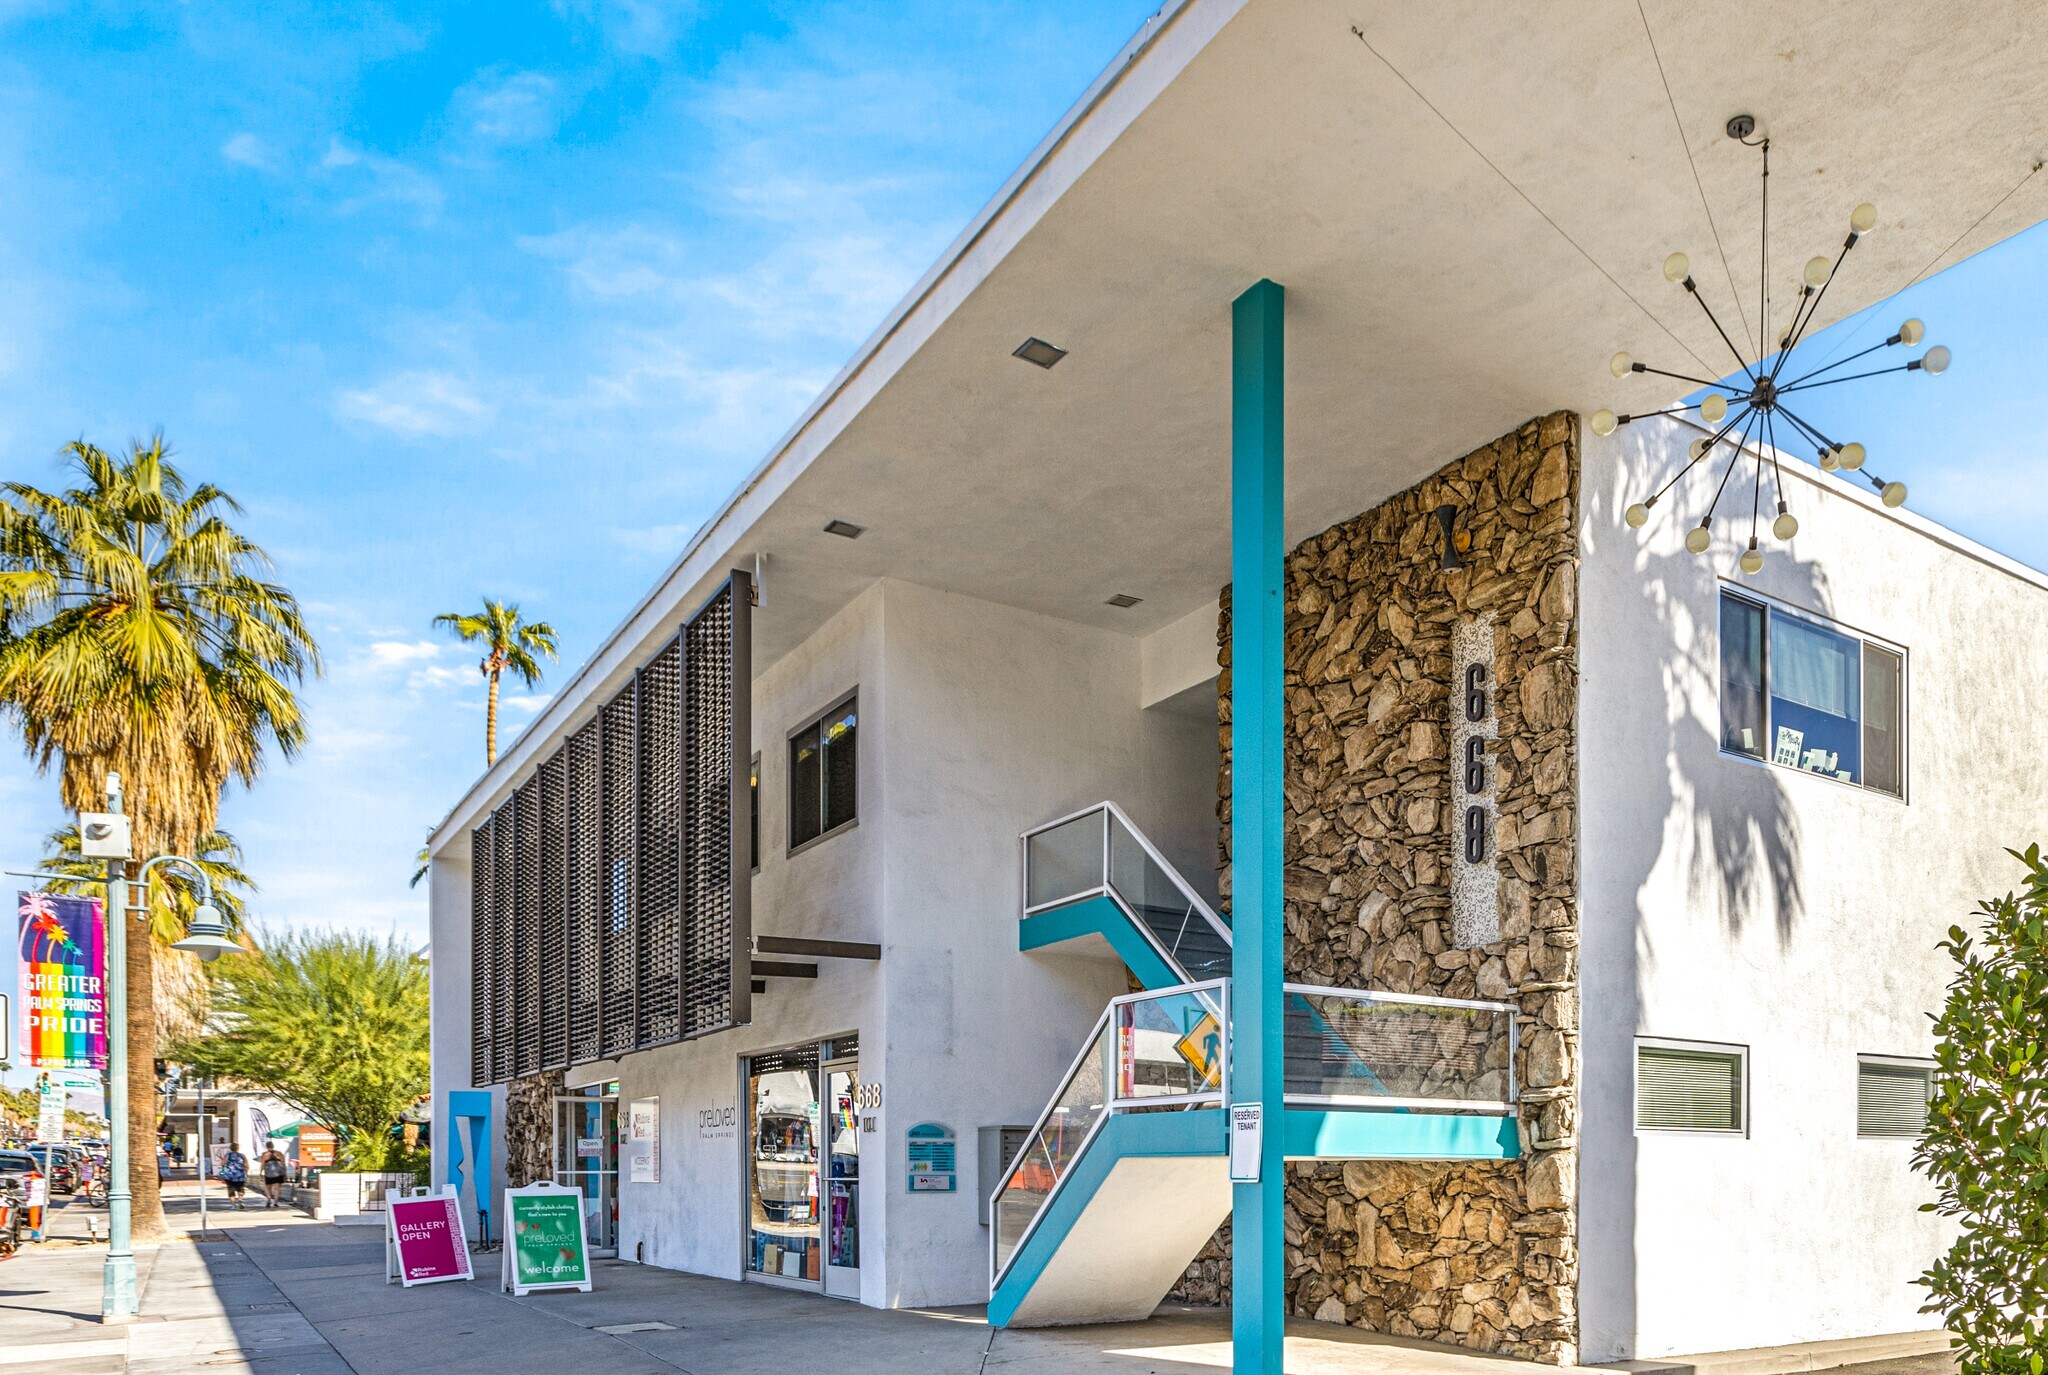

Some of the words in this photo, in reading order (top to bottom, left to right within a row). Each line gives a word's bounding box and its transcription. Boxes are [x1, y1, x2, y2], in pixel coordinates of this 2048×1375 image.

[1465, 662, 1486, 865] 668
[23, 973, 101, 994] GREATER
[23, 996, 53, 1010] PALM
[57, 998, 102, 1012] SPRINGS
[23, 1015, 103, 1034] PRIDE
[858, 1084, 882, 1110] 668
[699, 1095, 736, 1138] preLoved
[1234, 1110, 1260, 1121] RESERVED
[1237, 1121, 1257, 1131] TENANT
[400, 1220, 446, 1232] GALLERY
[402, 1231, 431, 1241] OPEN
[523, 1230, 576, 1247] preLoved
[524, 1260, 579, 1275] welcome
